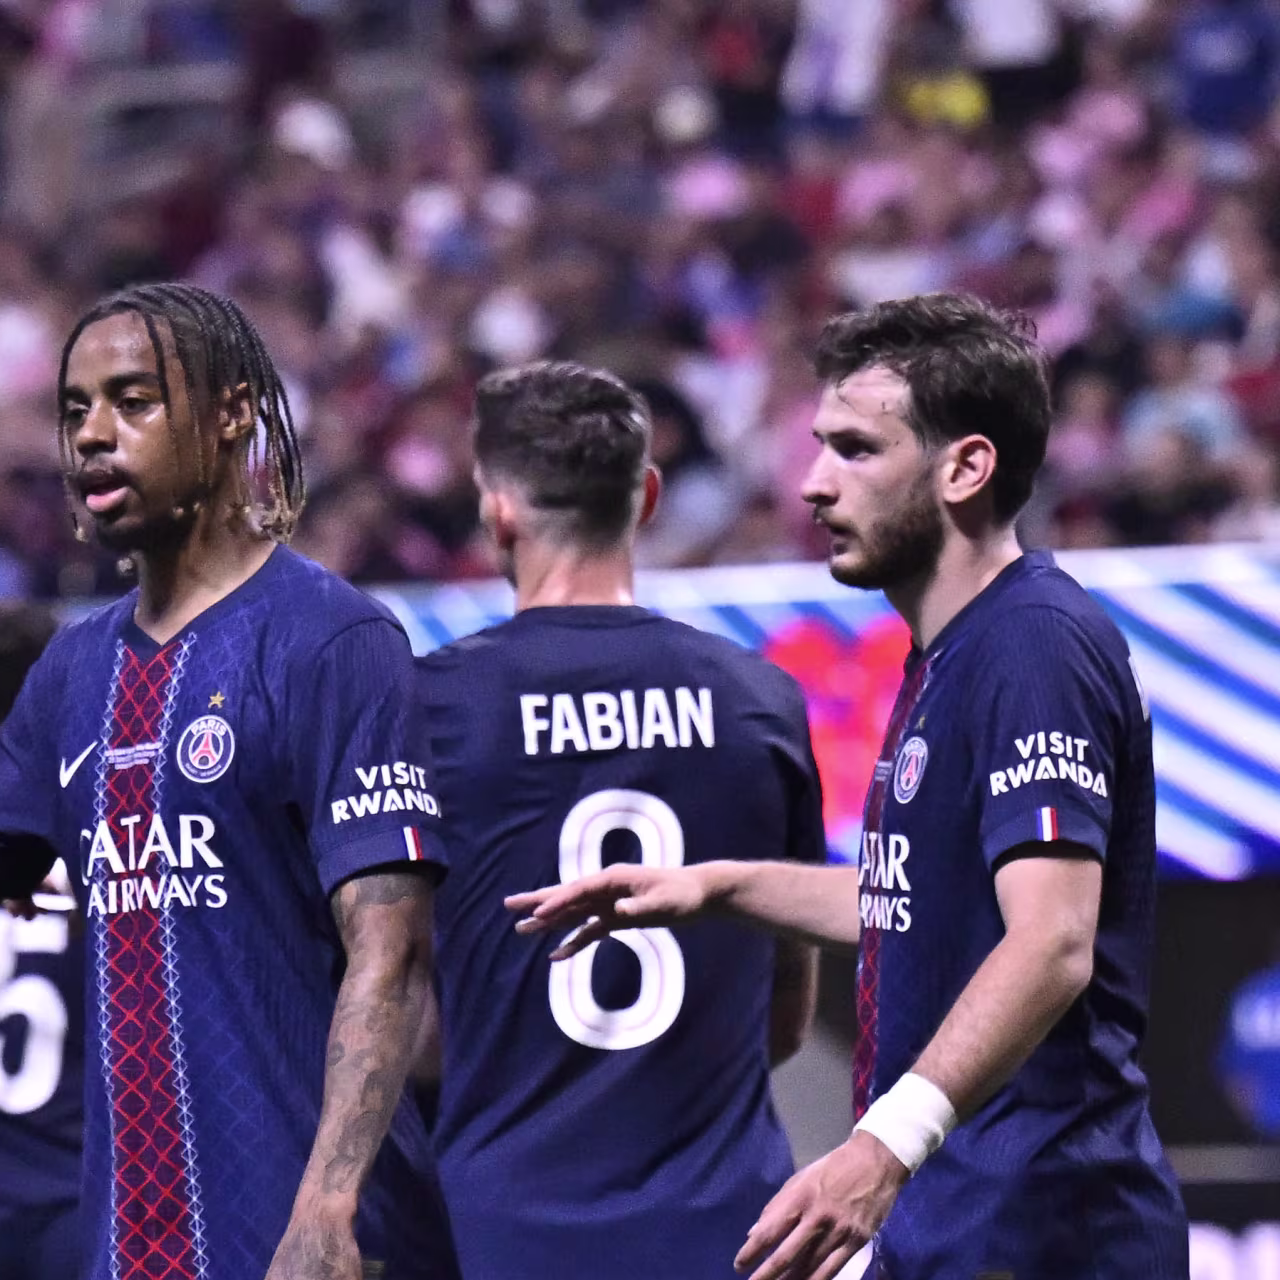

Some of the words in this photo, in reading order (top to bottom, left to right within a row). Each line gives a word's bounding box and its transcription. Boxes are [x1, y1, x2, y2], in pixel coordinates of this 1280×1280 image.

[191, 719, 227, 736] PARIS
[519, 686, 715, 756] FABIAN
[1014, 731, 1089, 762] VISIT
[354, 761, 426, 790] VISIT
[989, 756, 1108, 798] RWANDA
[331, 788, 442, 824] RWAND
[87, 873, 228, 918] AIRWAYS
[548, 788, 686, 1051] 8
